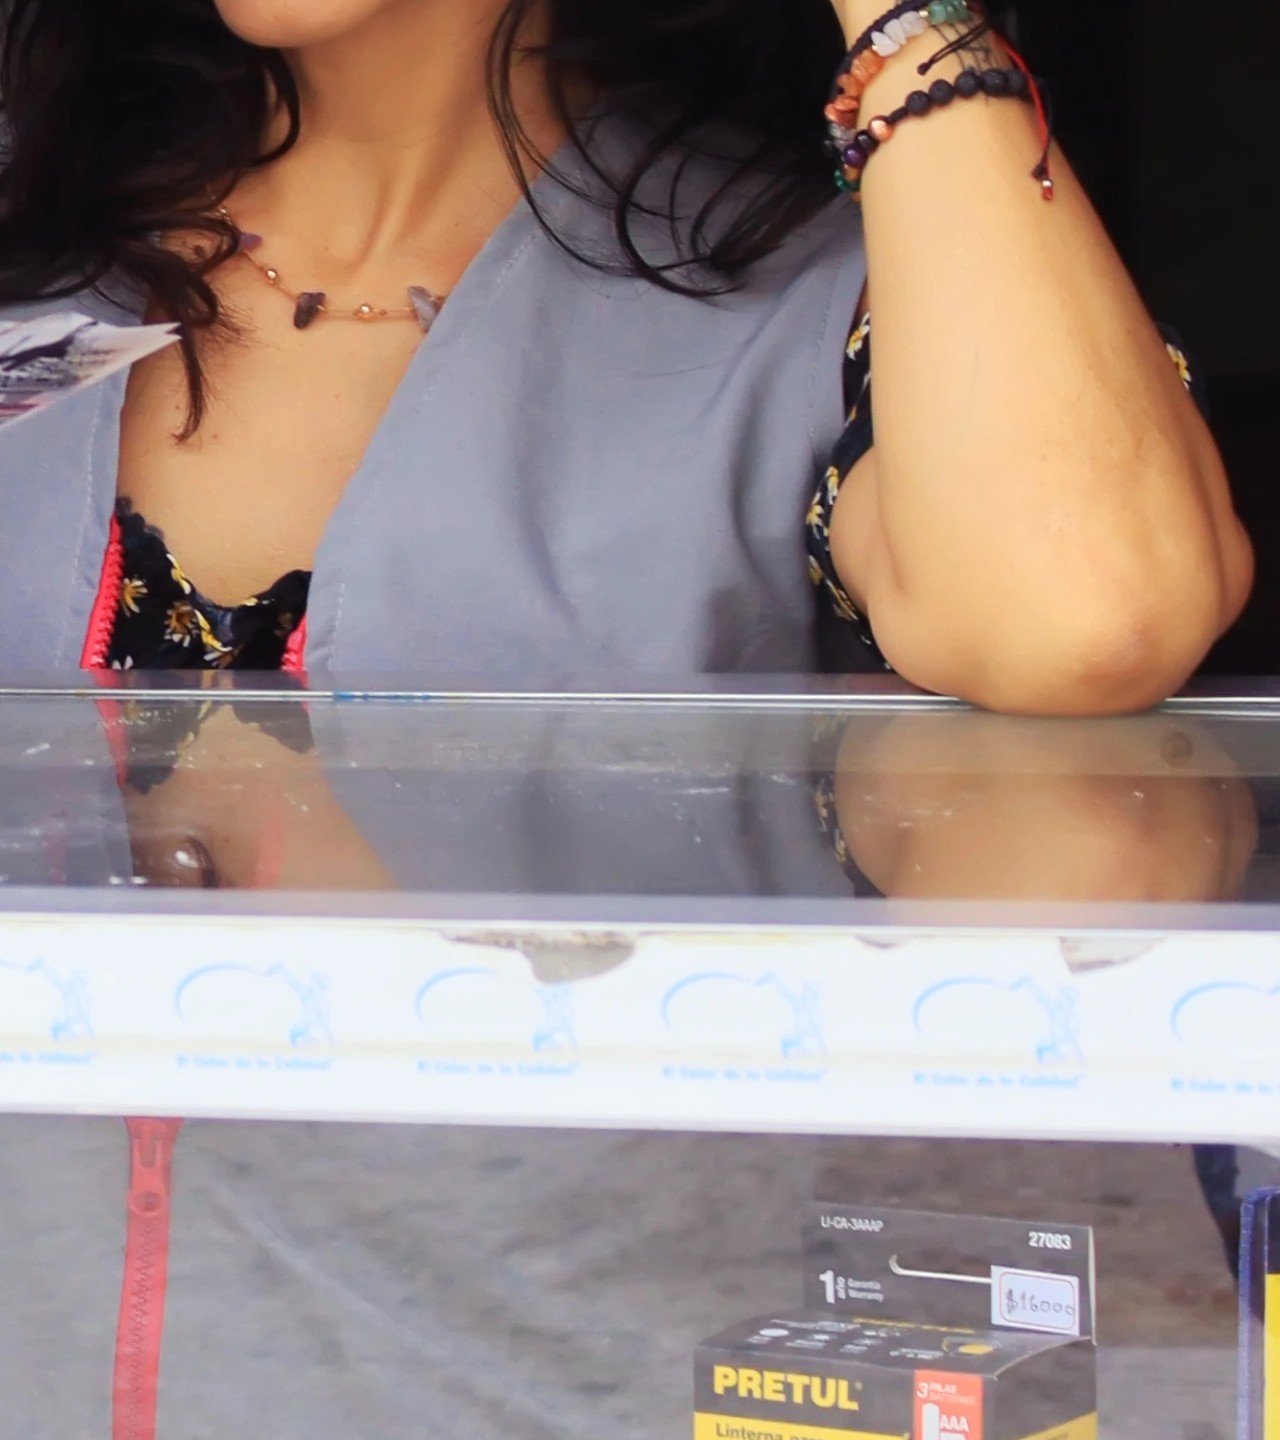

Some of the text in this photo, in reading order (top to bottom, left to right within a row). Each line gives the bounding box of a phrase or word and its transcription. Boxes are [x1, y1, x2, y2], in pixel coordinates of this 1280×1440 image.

[1028, 1231, 1072, 1251] 27083
[819, 1270, 836, 1304] 1
[713, 1364, 858, 1411] PRETUL
[916, 1381, 957, 1399] 3 PILAS
[940, 1414, 969, 1432] AAA
